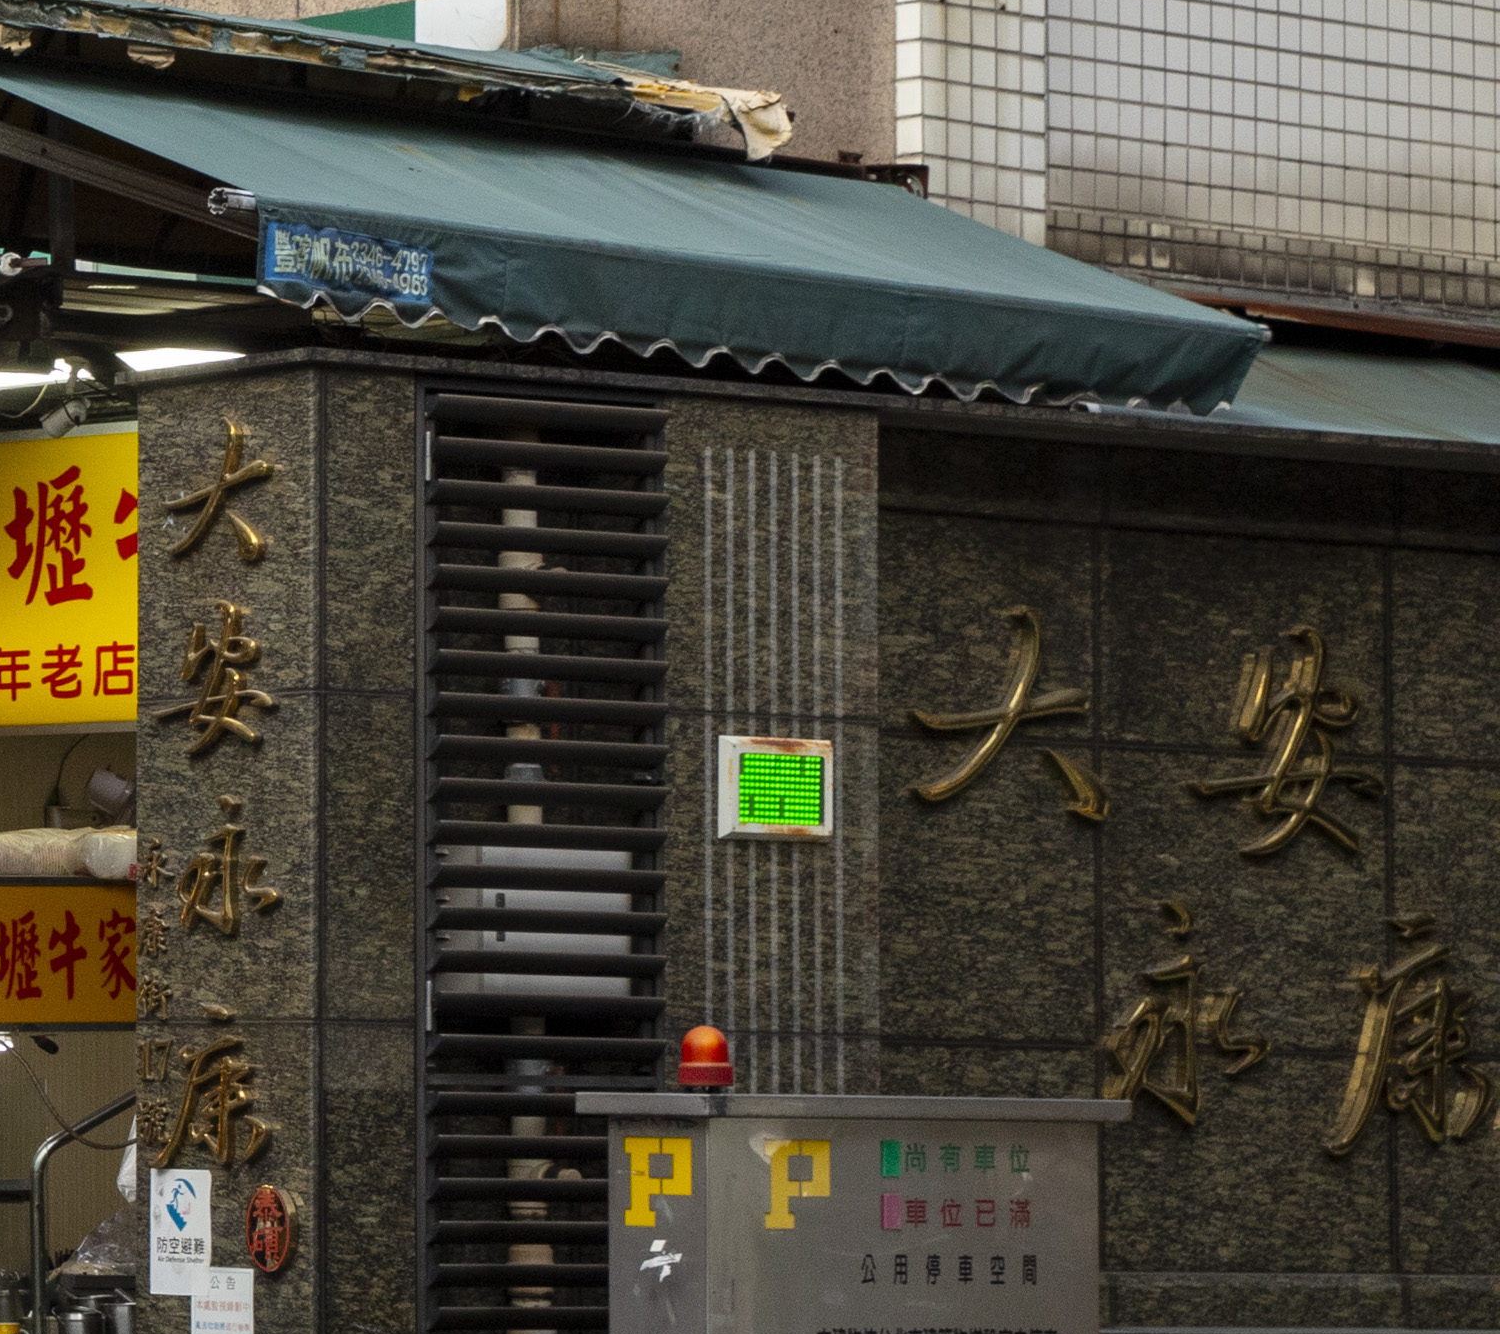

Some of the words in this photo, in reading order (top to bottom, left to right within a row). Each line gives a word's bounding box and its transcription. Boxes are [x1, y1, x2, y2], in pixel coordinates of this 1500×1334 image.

[352, 241, 428, 273] 2346-4797
[903, 1142, 1032, 1175] 尚有車位
[624, 1137, 693, 1227] P
[764, 1139, 831, 1229] P
[903, 1198, 1033, 1230] 車位已滿
[156, 1236, 206, 1255] 防空避難
[209, 1275, 236, 1291] 公告
[859, 1253, 1038, 1286] 公用停車空間
